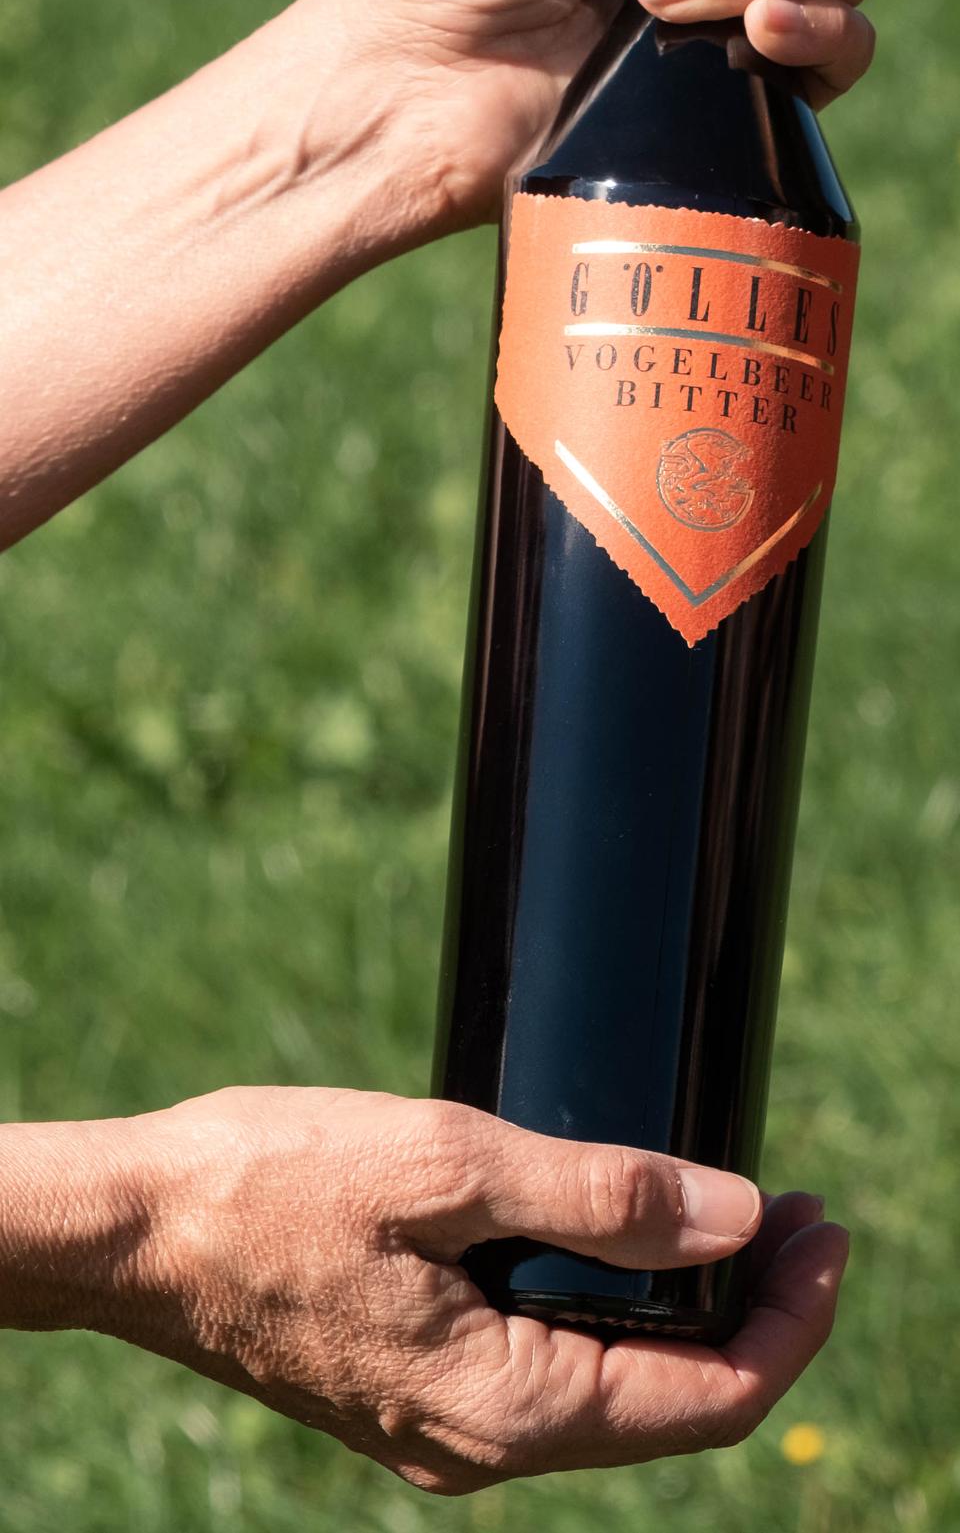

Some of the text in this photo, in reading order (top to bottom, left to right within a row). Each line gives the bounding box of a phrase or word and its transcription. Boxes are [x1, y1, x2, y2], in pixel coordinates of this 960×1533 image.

[570, 261, 841, 357] GÖLLES
[564, 343, 833, 413] VOGELBEER
[615, 379, 799, 435] BITTER
